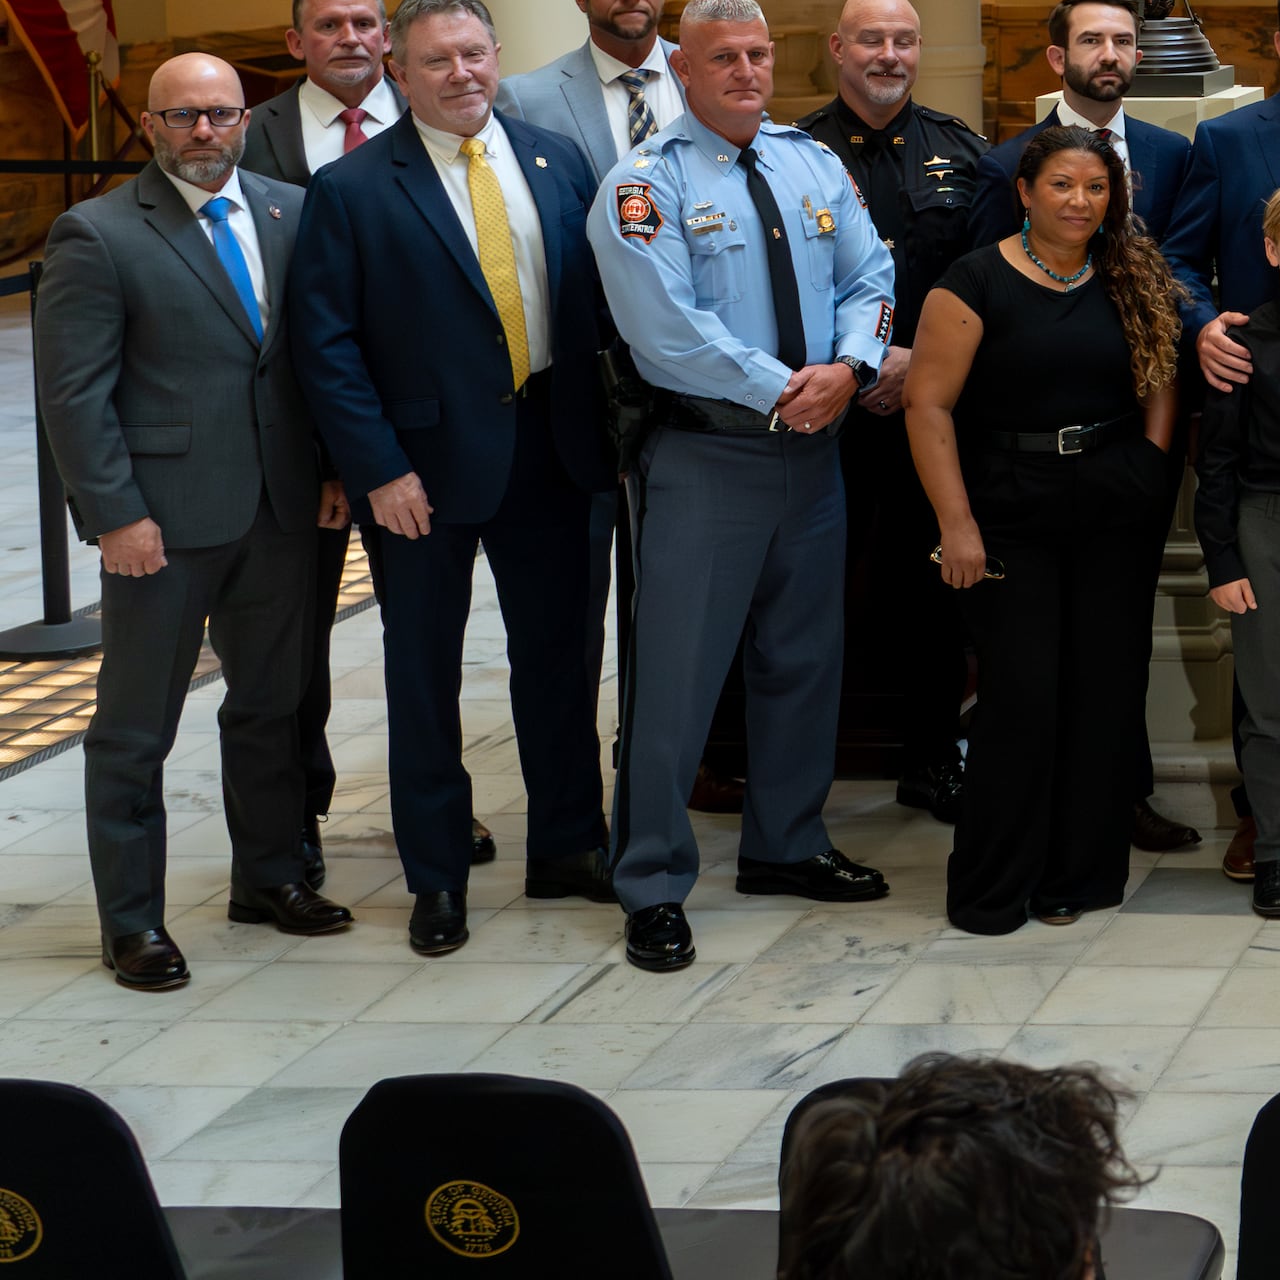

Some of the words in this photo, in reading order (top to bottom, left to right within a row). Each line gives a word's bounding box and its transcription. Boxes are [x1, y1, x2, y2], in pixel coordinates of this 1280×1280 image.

[431, 1193, 449, 1225] STATE
[448, 1184, 465, 1195] OF
[471, 1185, 515, 1226] GEORGIA
